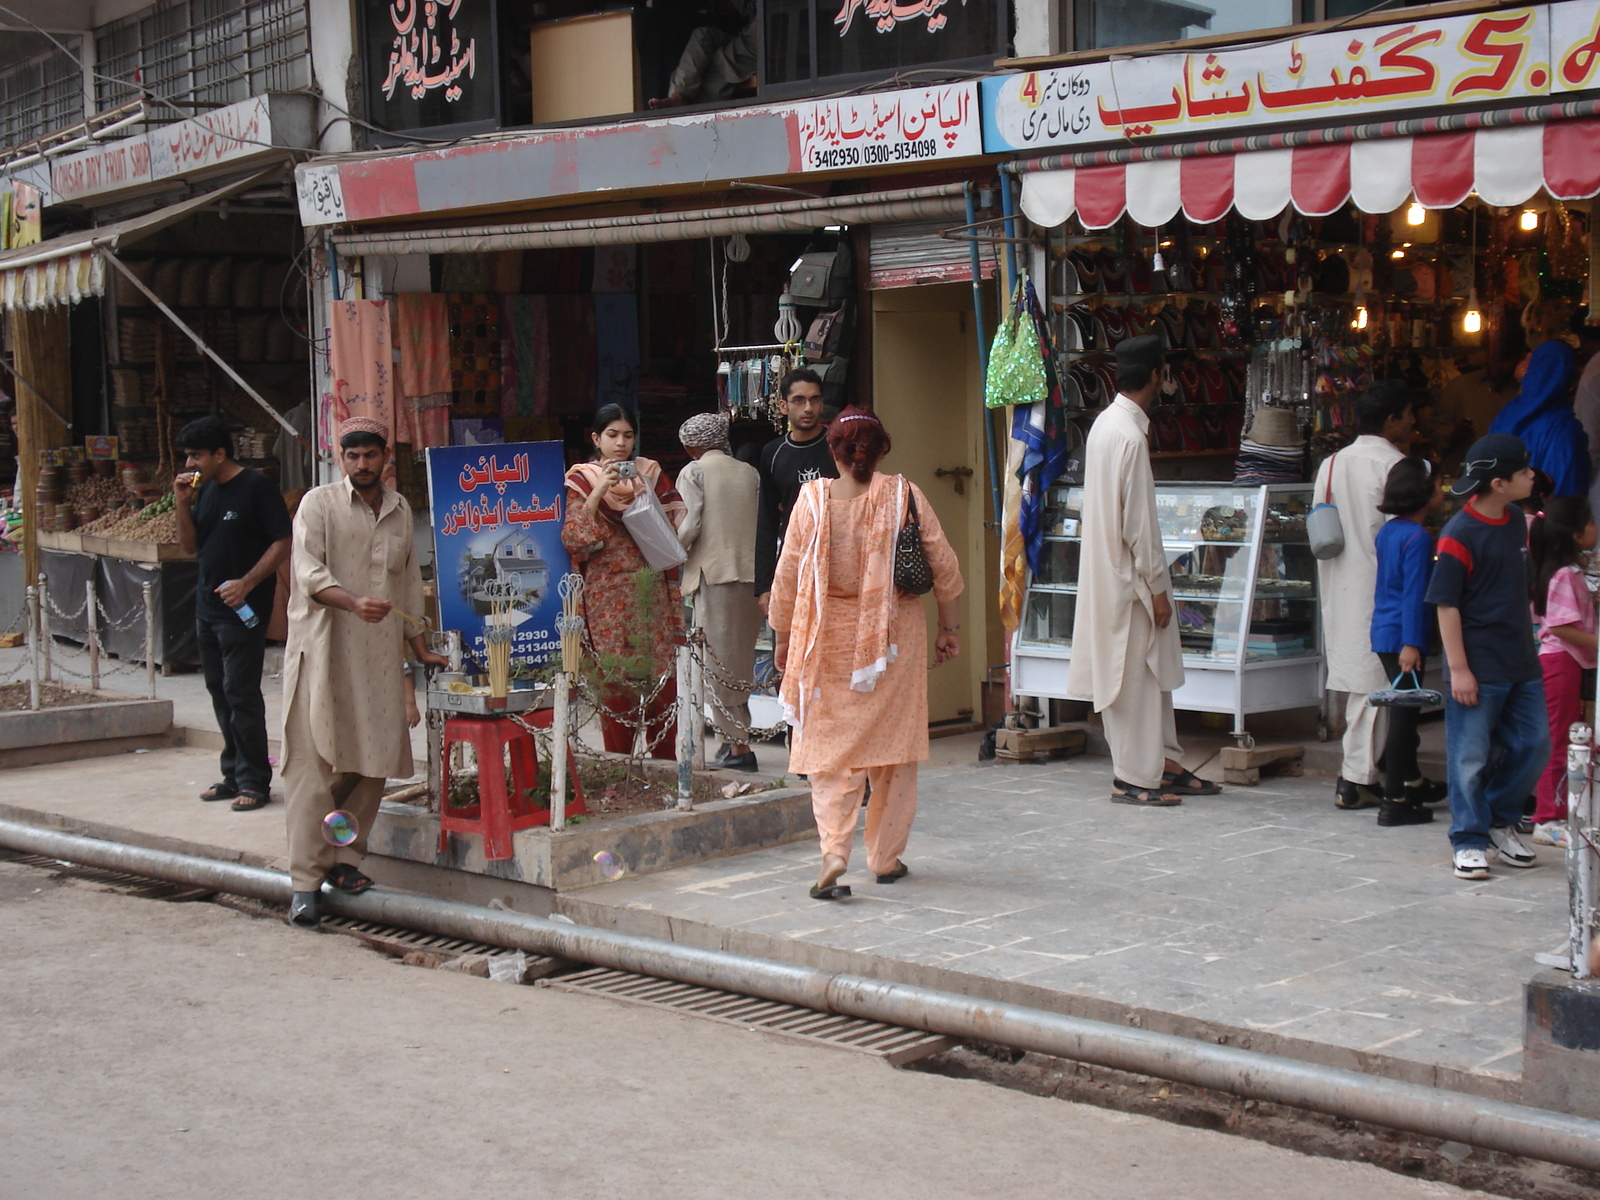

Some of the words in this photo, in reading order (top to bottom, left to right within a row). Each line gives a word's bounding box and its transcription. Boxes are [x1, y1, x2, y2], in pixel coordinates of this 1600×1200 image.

[1256, 24, 1445, 112] گفٹ
[1019, 71, 1041, 109] 4
[1096, 52, 1254, 139] شاپ
[458, 452, 530, 495] الپائن
[505, 493, 562, 530] اسٹیٹ
